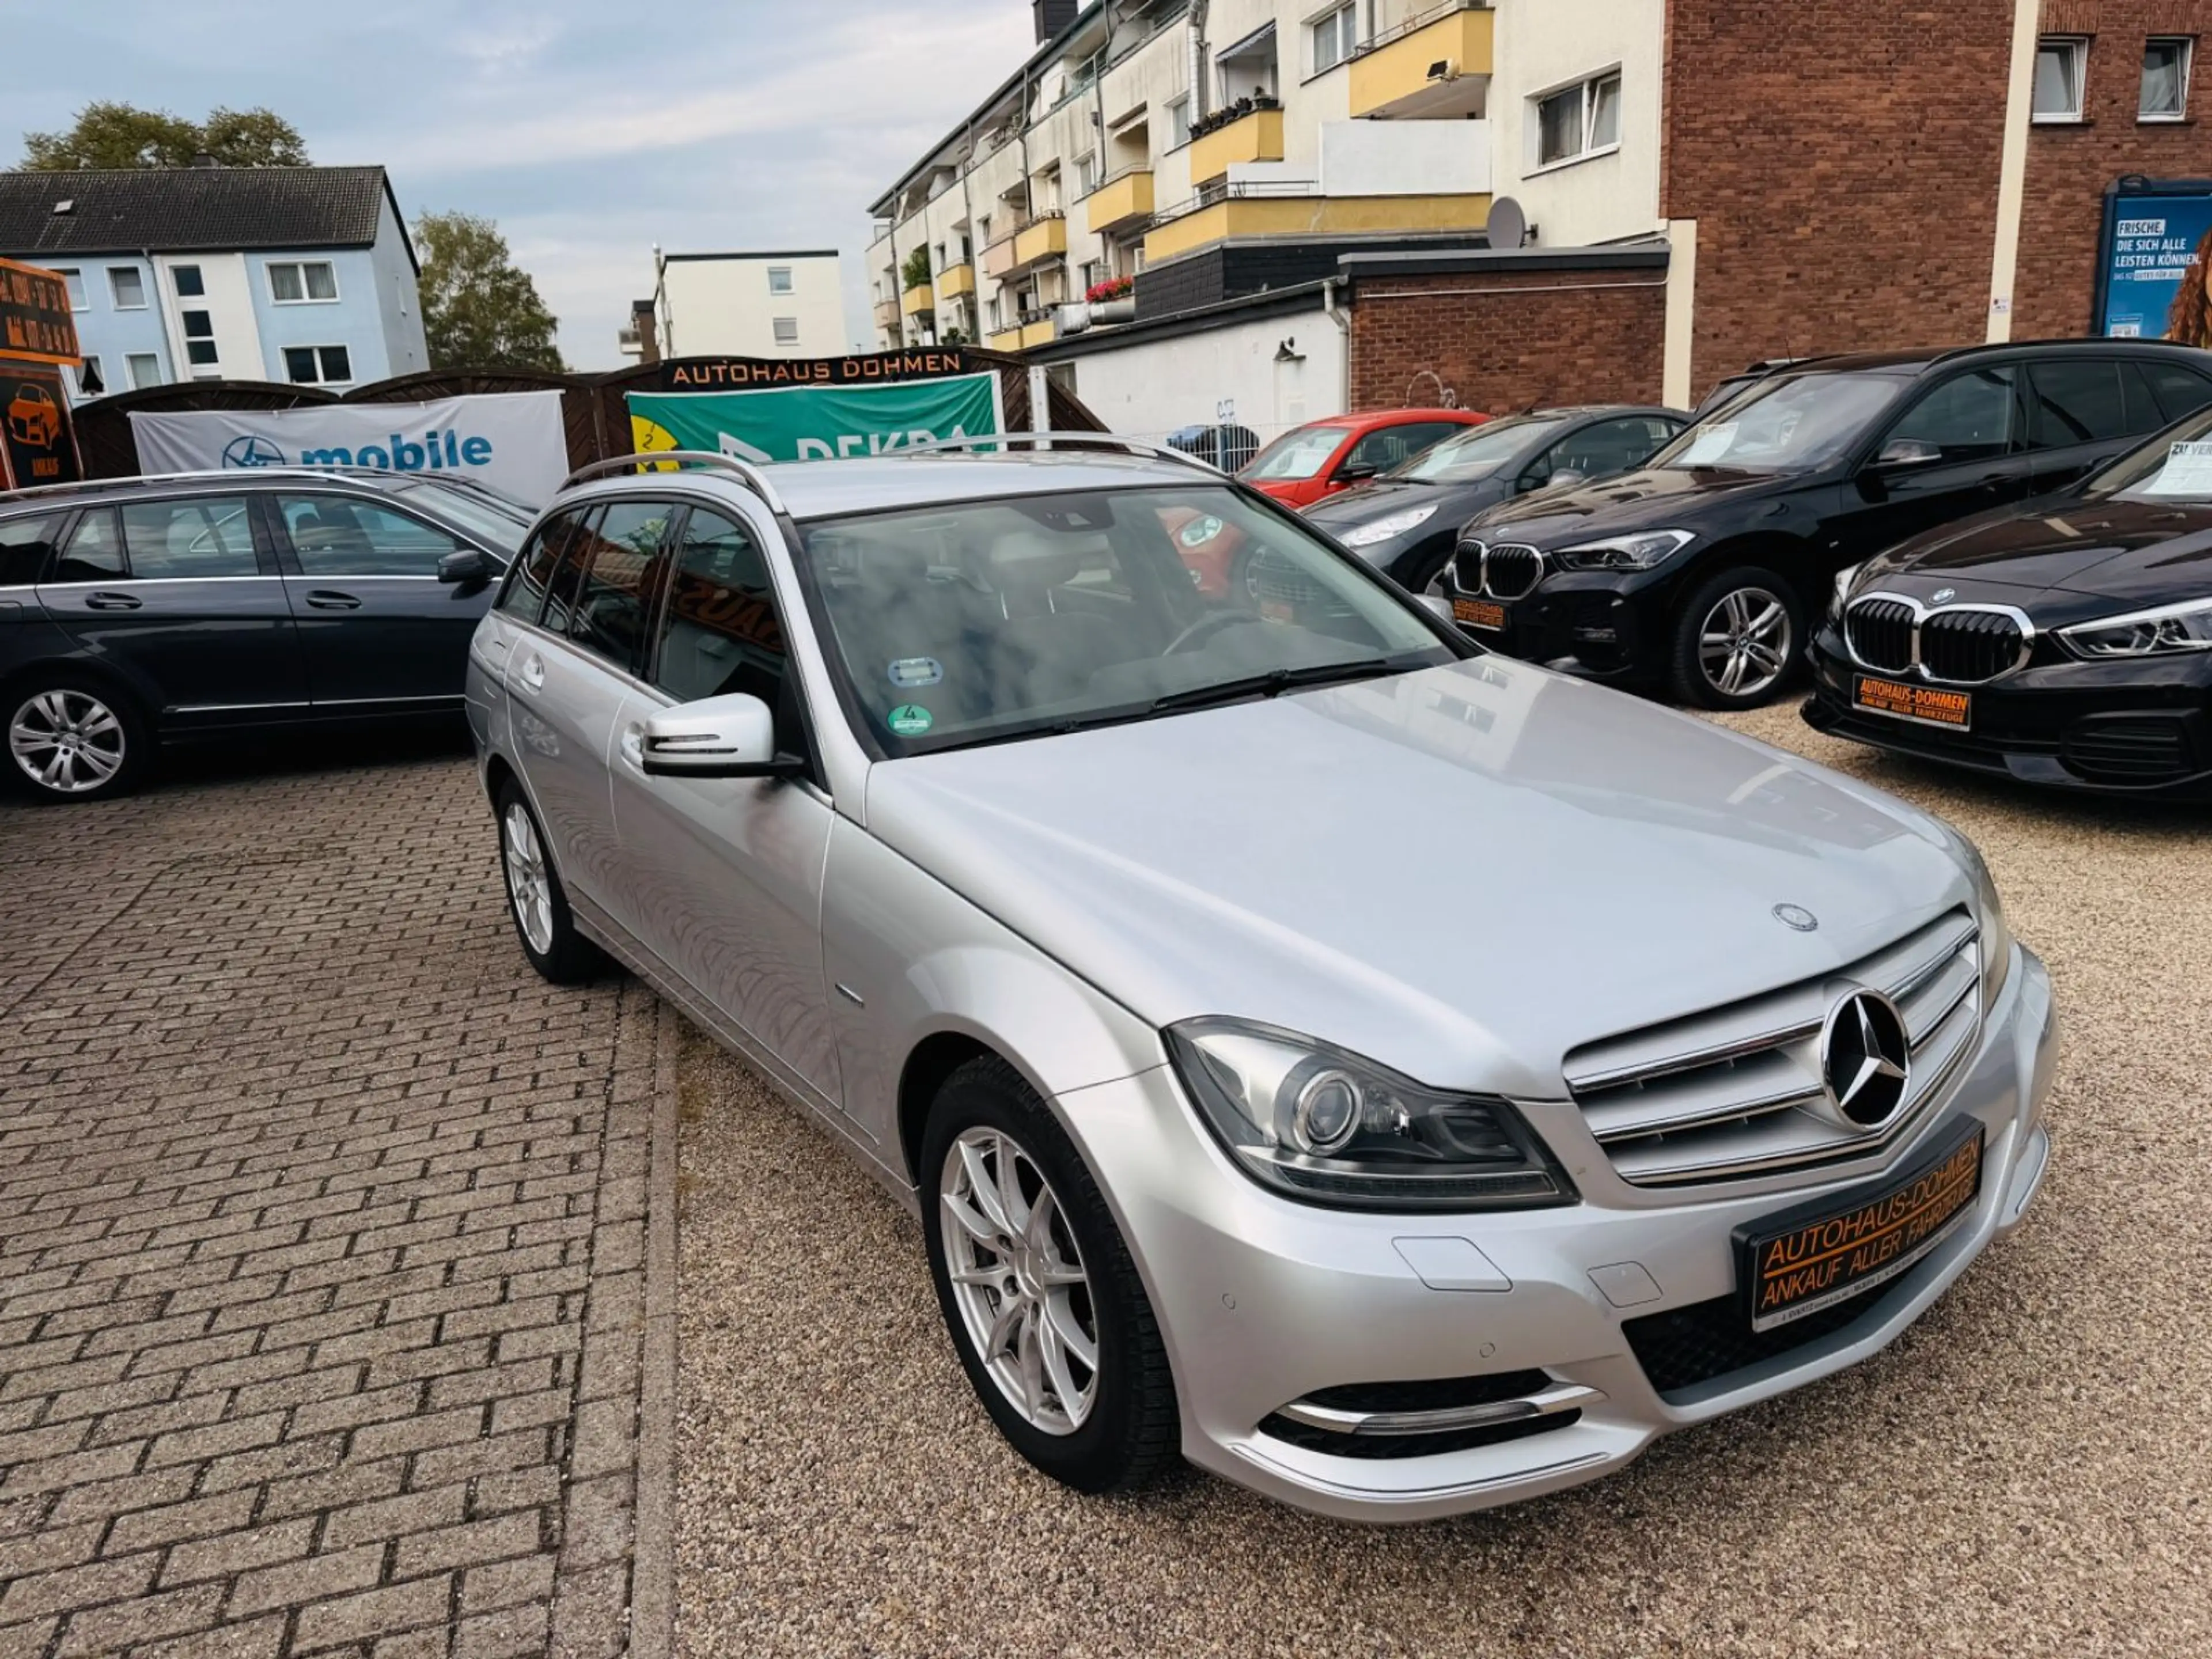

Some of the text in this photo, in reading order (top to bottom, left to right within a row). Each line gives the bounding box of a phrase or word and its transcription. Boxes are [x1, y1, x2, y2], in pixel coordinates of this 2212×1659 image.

[2117, 238, 2187, 252] DIE SICH ALLE
[2115, 255, 2156, 267] LEISTEN
[673, 353, 960, 384] AUTOHAUS DOHMEN
[301, 429, 493, 470] mobile
[903, 706, 917, 719] 4
[1764, 1137, 1979, 1271] AUTOHAUS-DOHMEN
[1762, 1257, 1843, 1309] ANKAUF
[1849, 1233, 1903, 1277] ALLER
